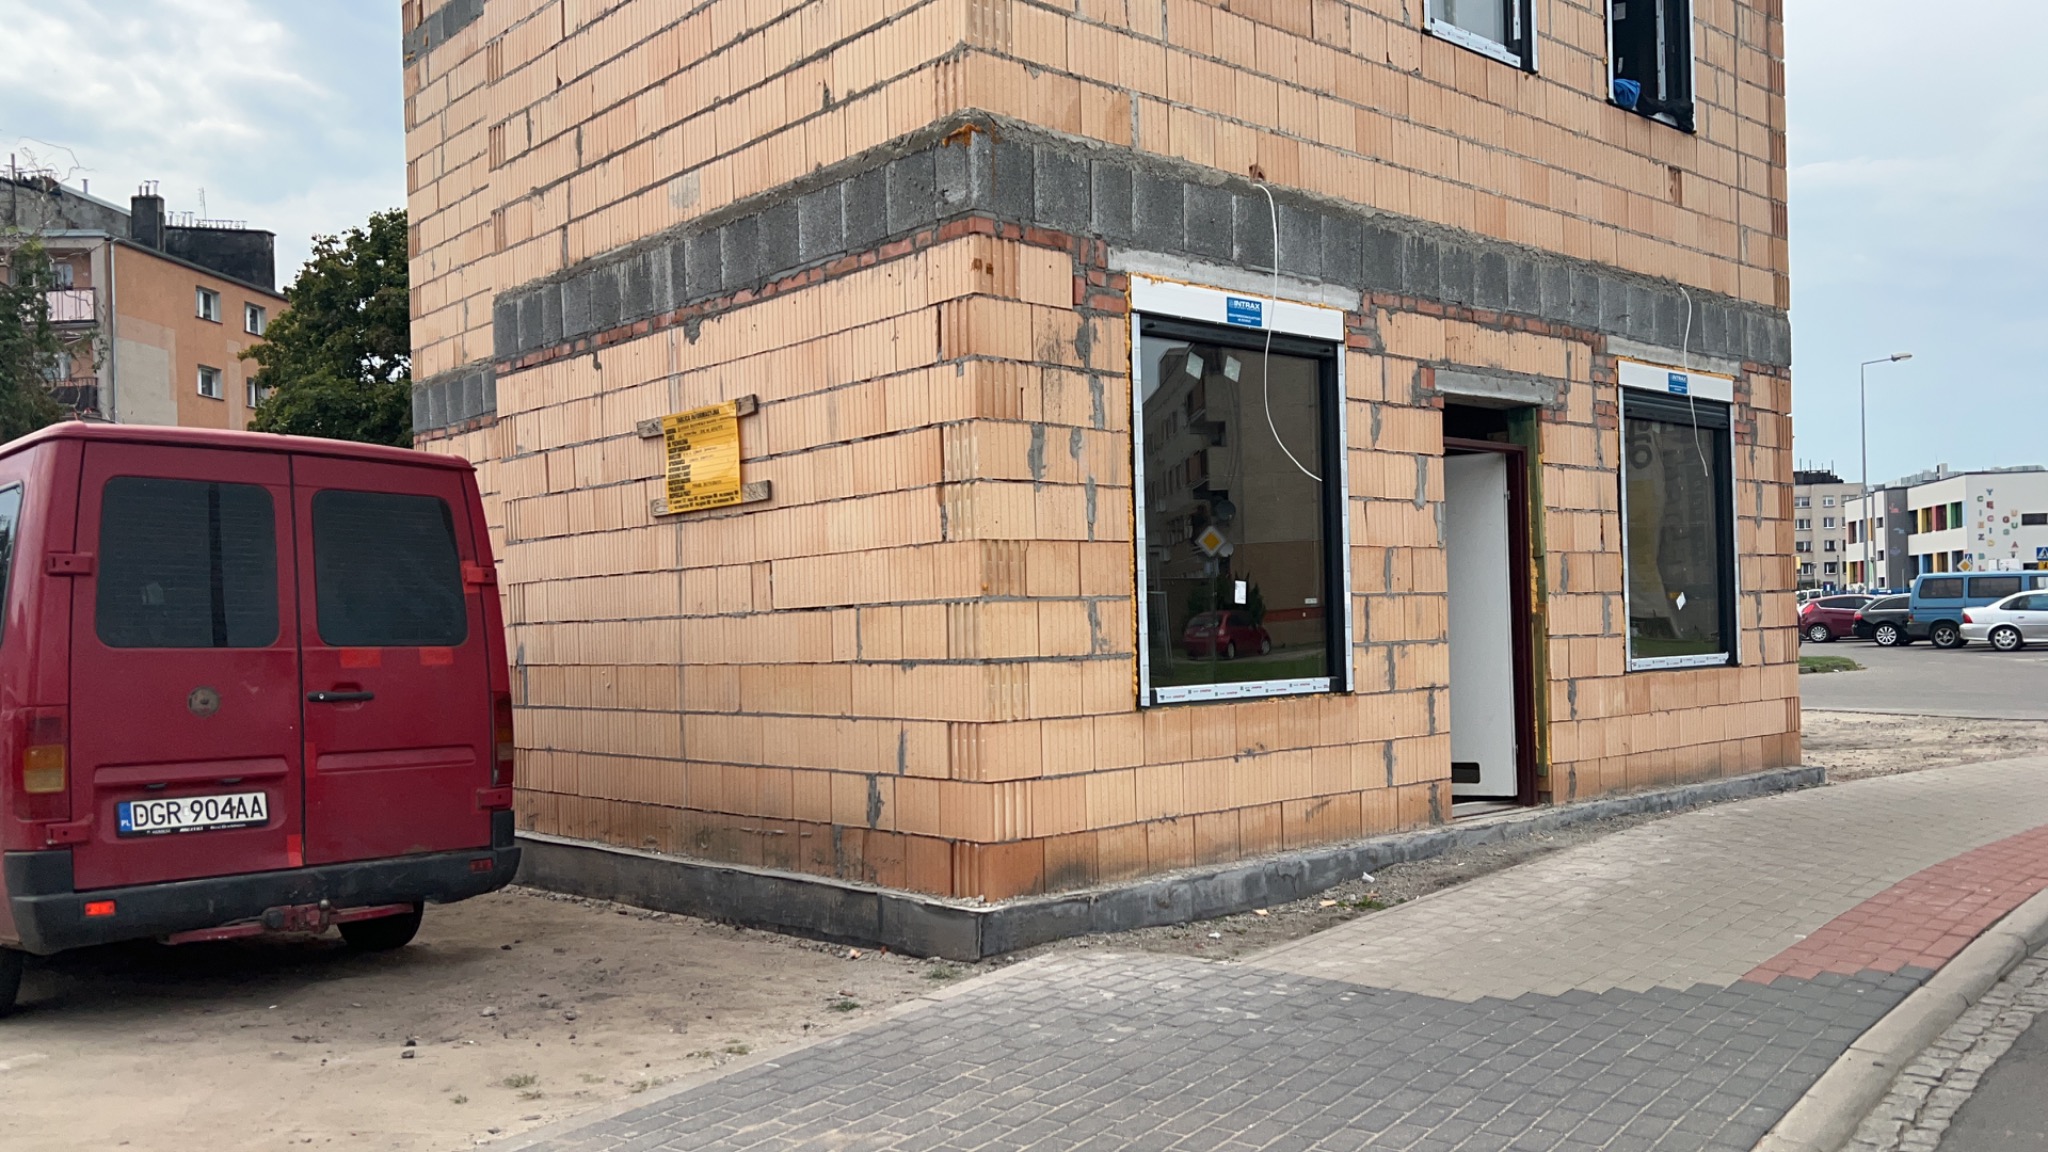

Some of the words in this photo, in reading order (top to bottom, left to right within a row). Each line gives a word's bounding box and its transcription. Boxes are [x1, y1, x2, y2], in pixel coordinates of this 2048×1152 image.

[133, 801, 182, 827] DGR
[190, 795, 264, 822] 904AA
[121, 819, 131, 827] PL
